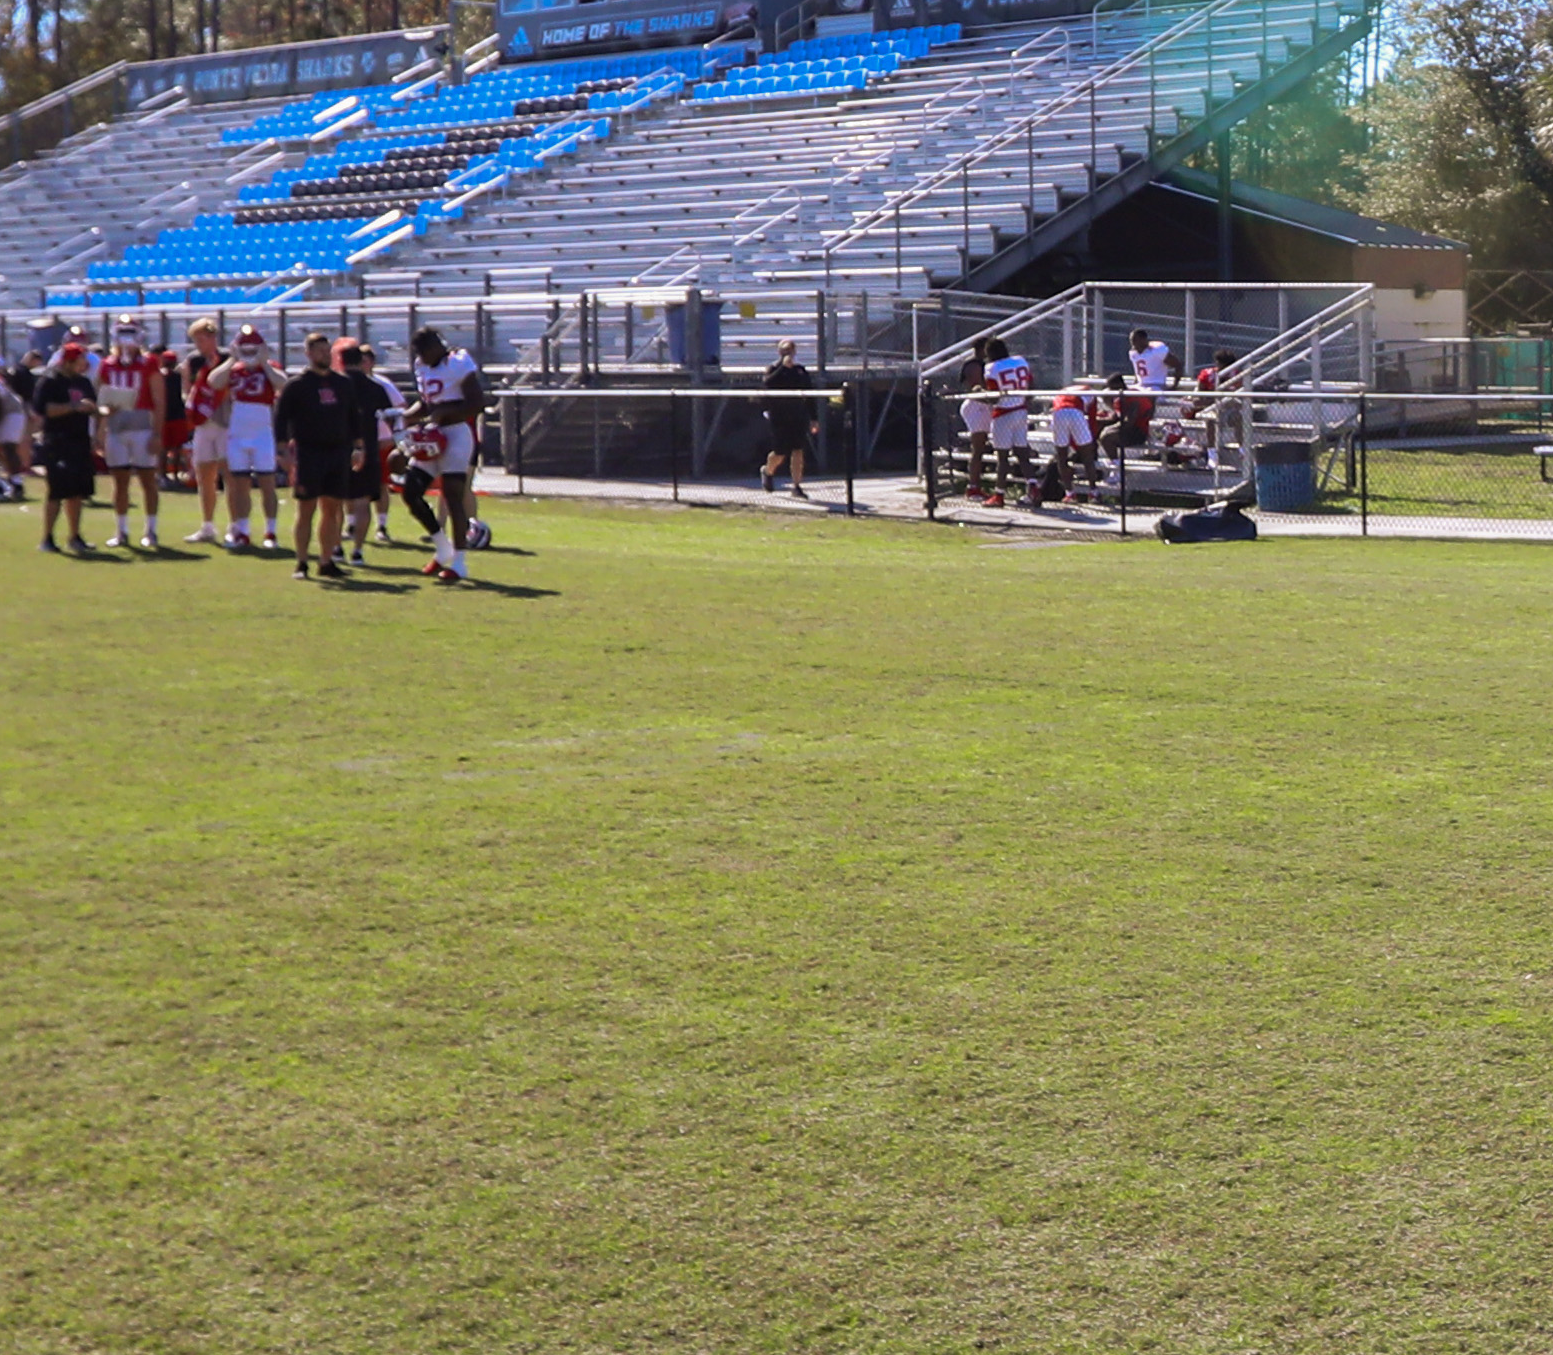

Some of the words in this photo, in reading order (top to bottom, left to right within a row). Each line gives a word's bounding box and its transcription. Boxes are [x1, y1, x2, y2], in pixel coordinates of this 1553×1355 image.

[542, 25, 586, 44] HOME
[588, 22, 611, 40] OF
[614, 18, 645, 35] THE
[648, 10, 716, 32] SHARKS
[998, 365, 1030, 391] 58
[1135, 359, 1149, 377] 6
